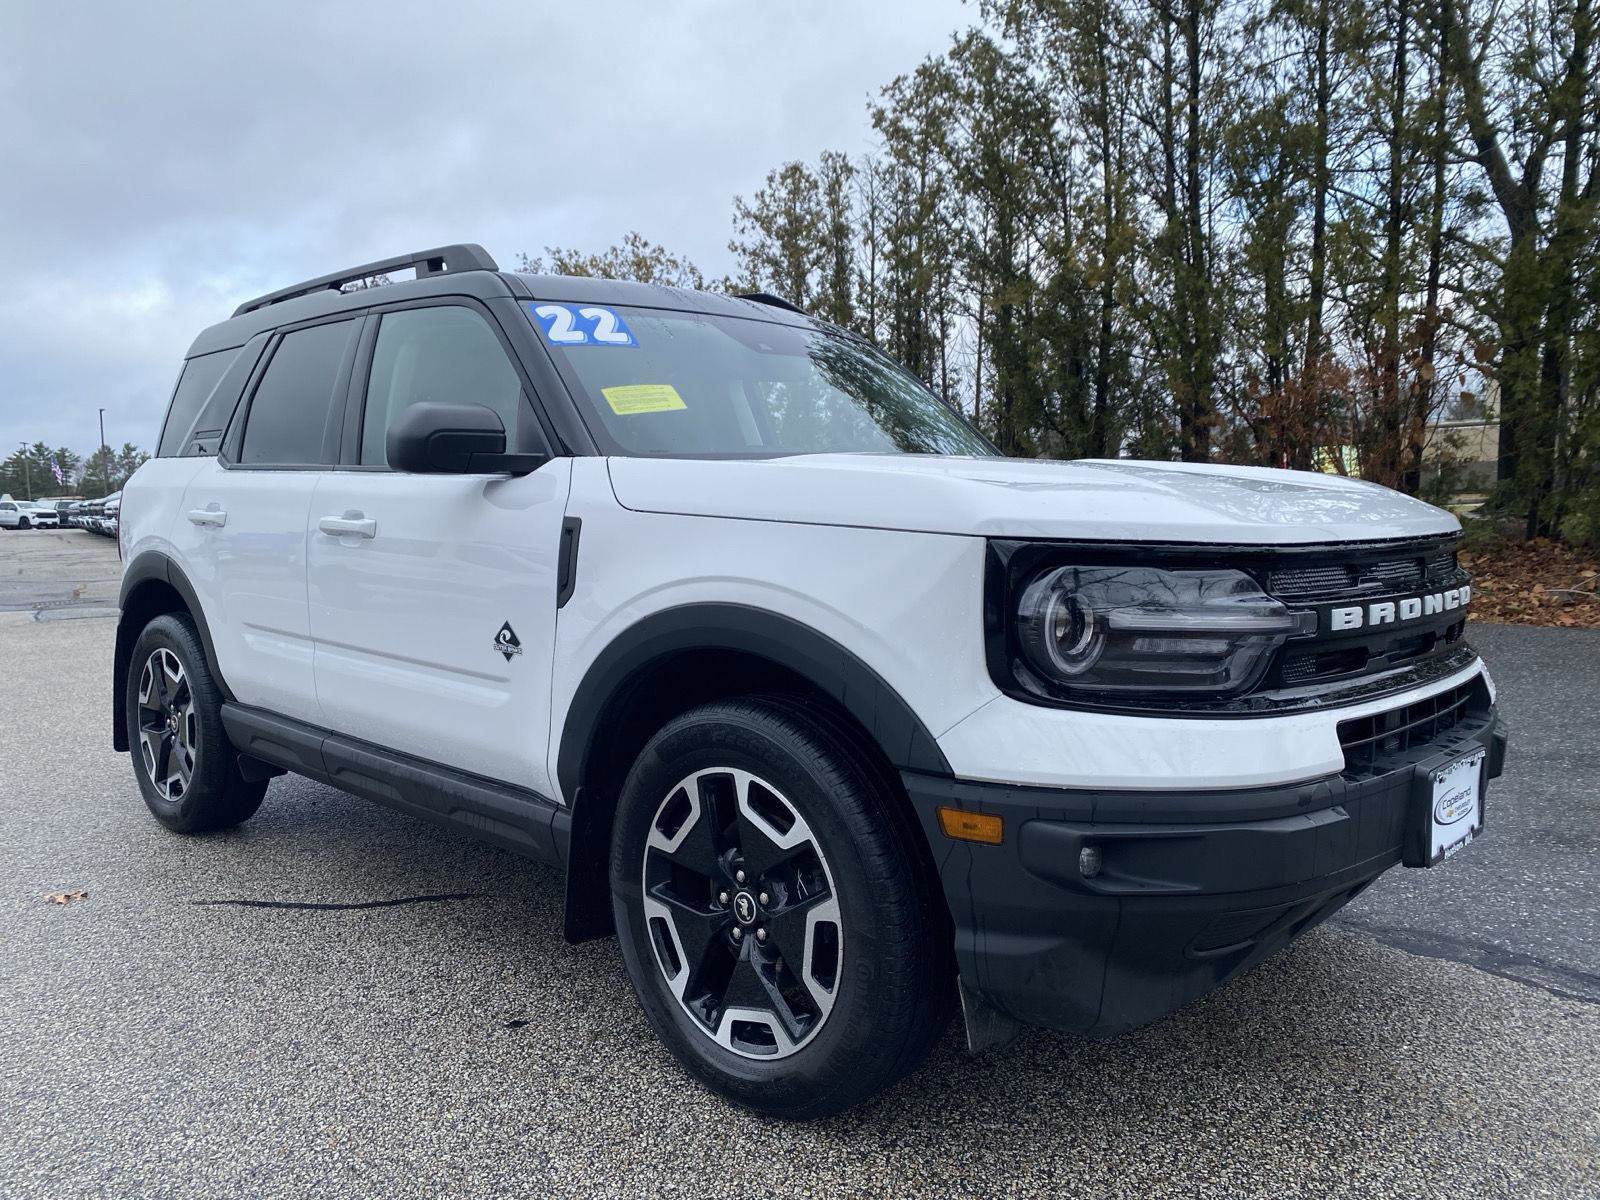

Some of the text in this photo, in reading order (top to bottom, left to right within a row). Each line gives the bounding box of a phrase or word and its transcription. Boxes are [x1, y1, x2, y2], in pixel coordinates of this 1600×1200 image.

[534, 305, 632, 345] 22
[1331, 585, 1471, 631] BRONCO
[1442, 786, 1472, 810] Copeland
